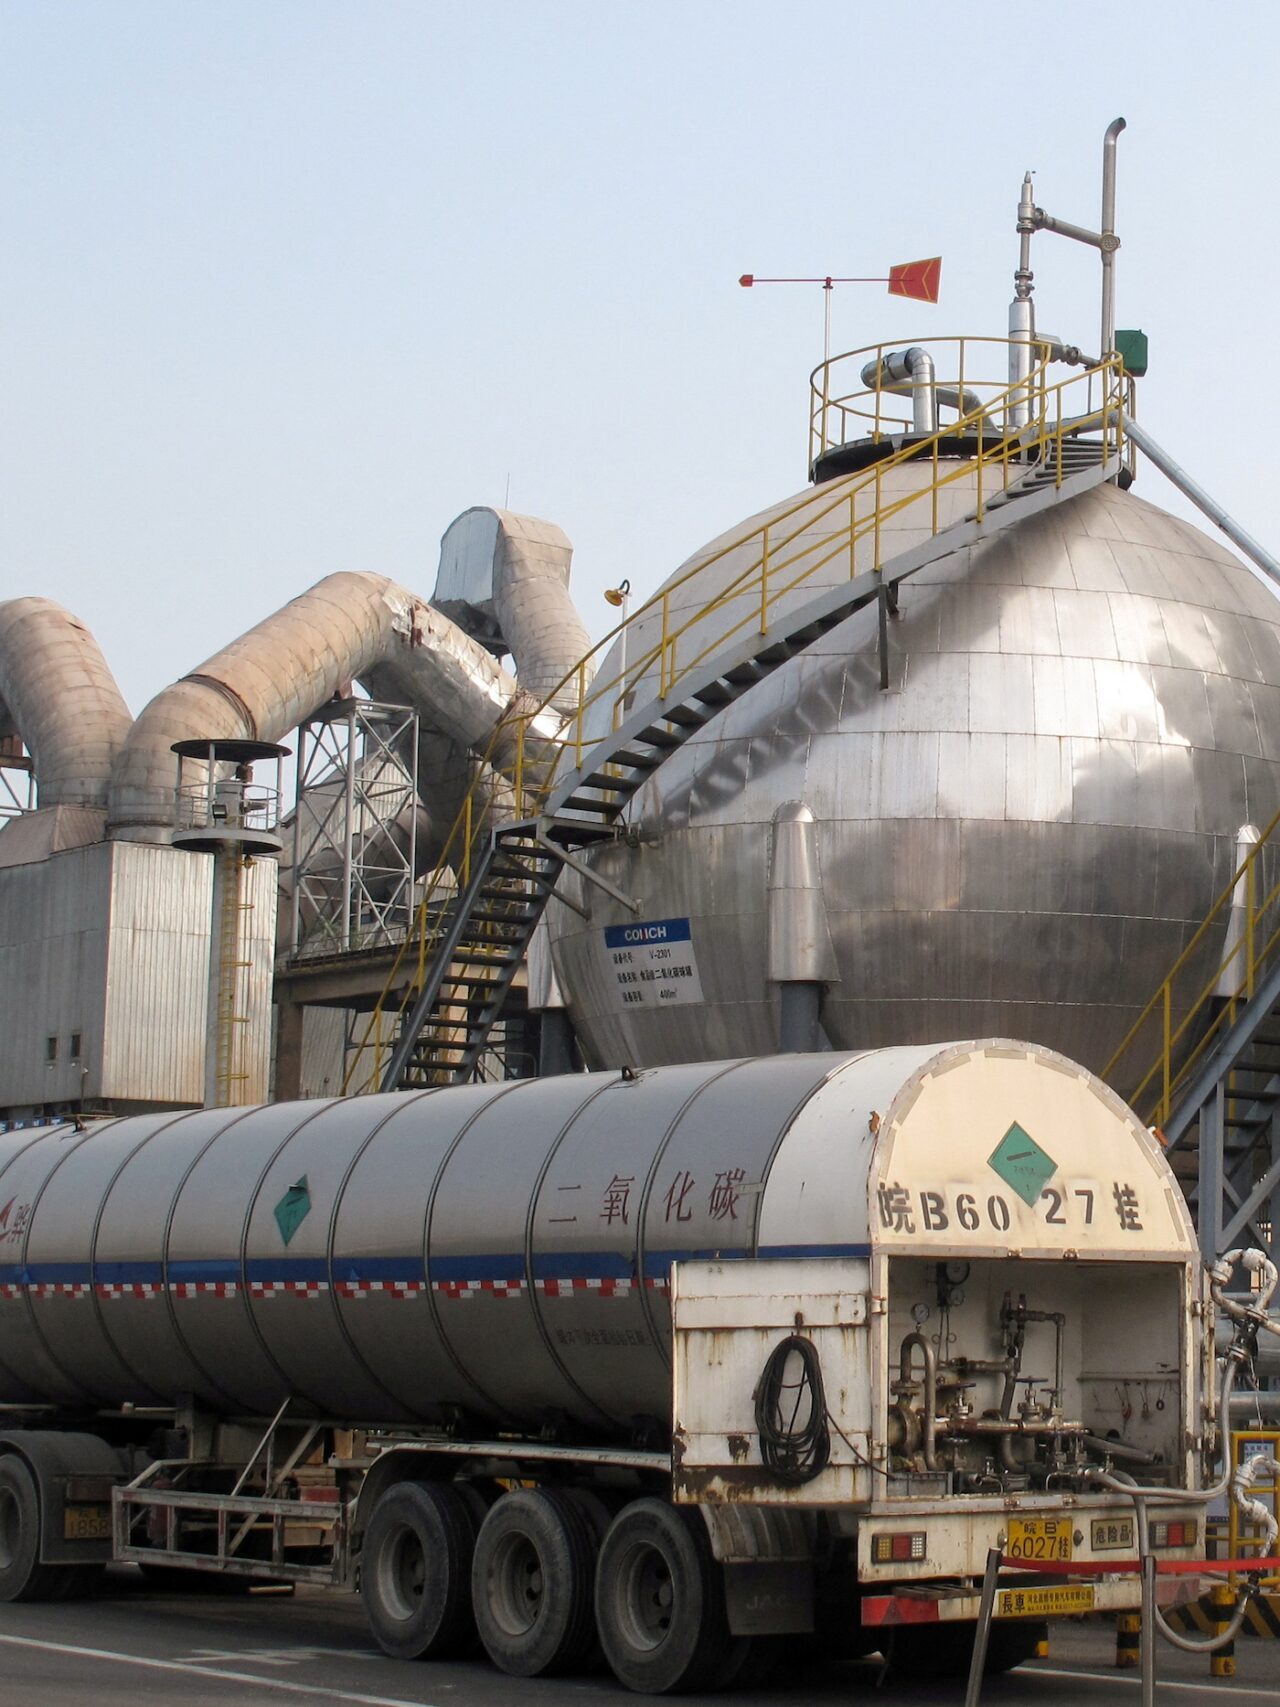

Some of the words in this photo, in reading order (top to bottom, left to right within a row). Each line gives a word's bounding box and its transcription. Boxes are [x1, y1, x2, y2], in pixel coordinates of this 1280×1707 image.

[624, 926, 667, 941] CONCH
[548, 1168, 746, 1225] 二氧化碳
[1096, 1524, 1130, 1544] 危险品
[1011, 1536, 1069, 1558] 6027挂
